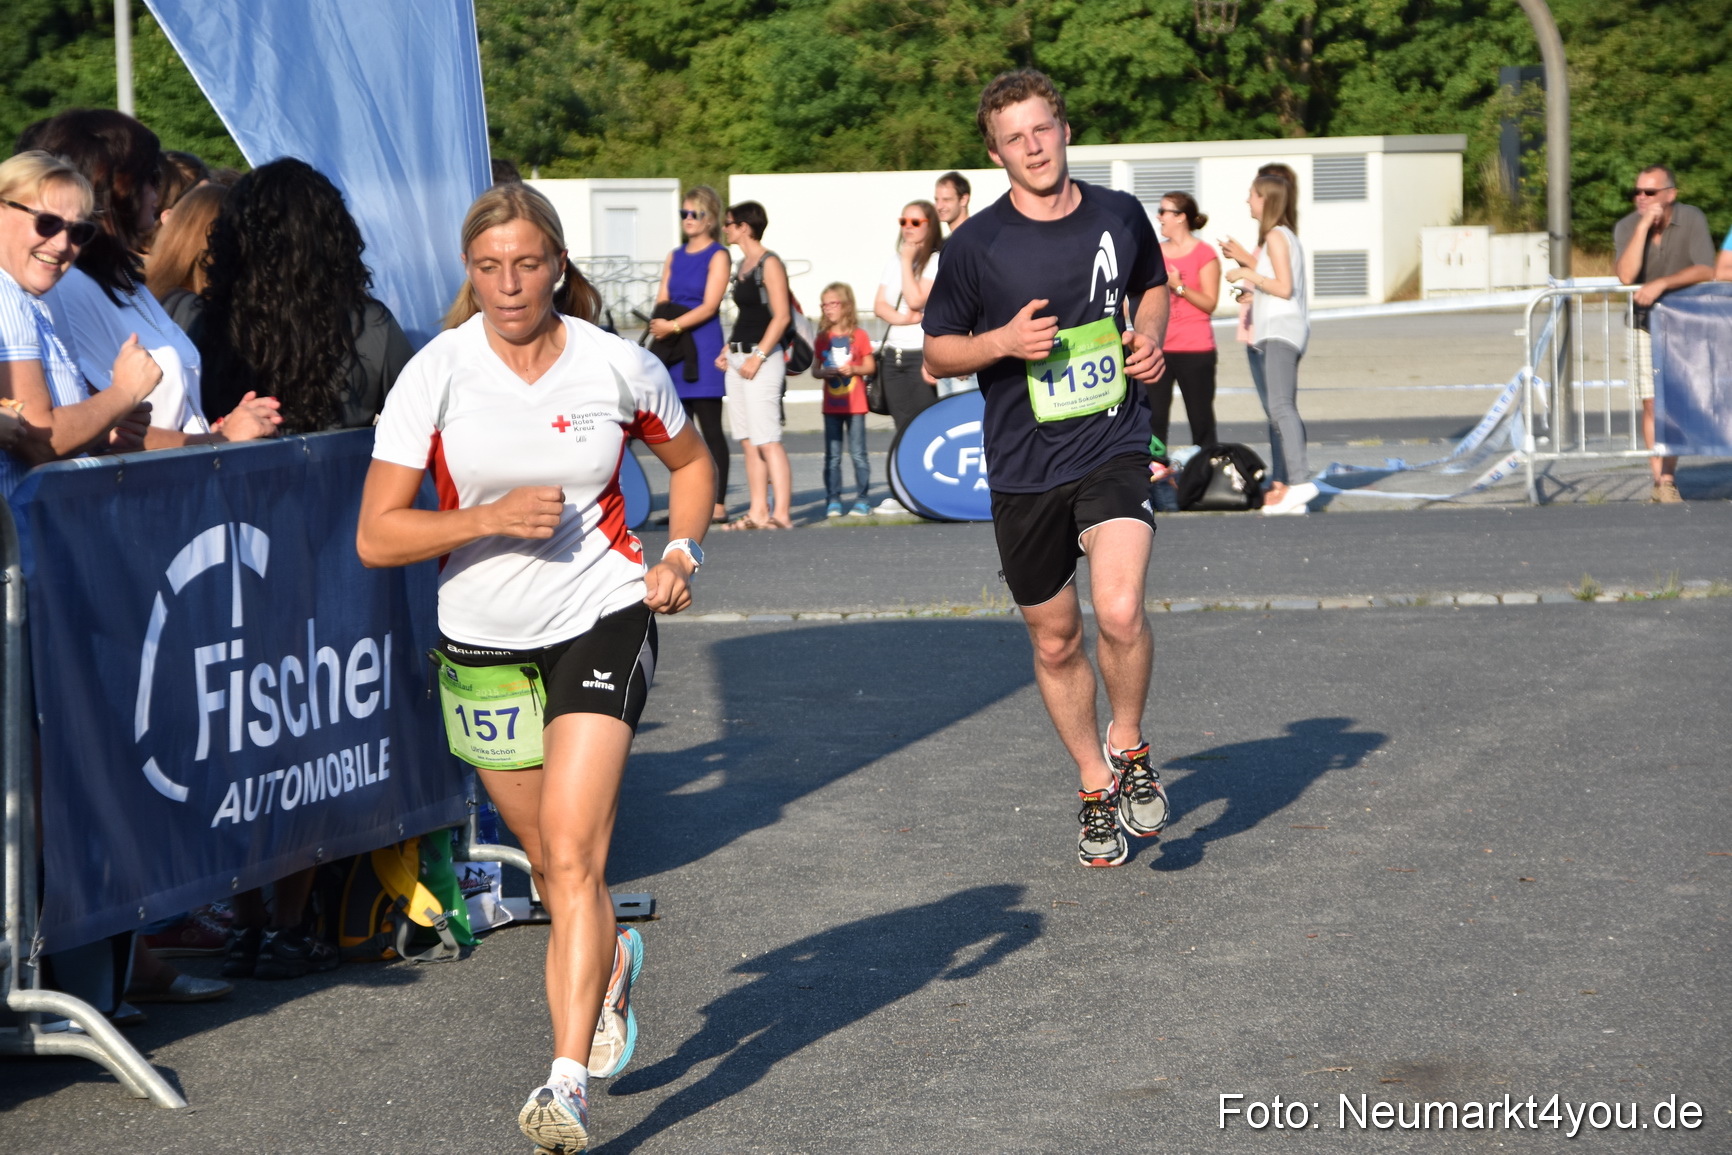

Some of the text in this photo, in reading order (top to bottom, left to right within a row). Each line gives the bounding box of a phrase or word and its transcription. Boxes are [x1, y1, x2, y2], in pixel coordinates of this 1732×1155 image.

[1040, 355, 1116, 397] 1139
[582, 679, 615, 691] erima
[455, 704, 520, 742] 157
[211, 736, 391, 828] AUTOMOBILE
